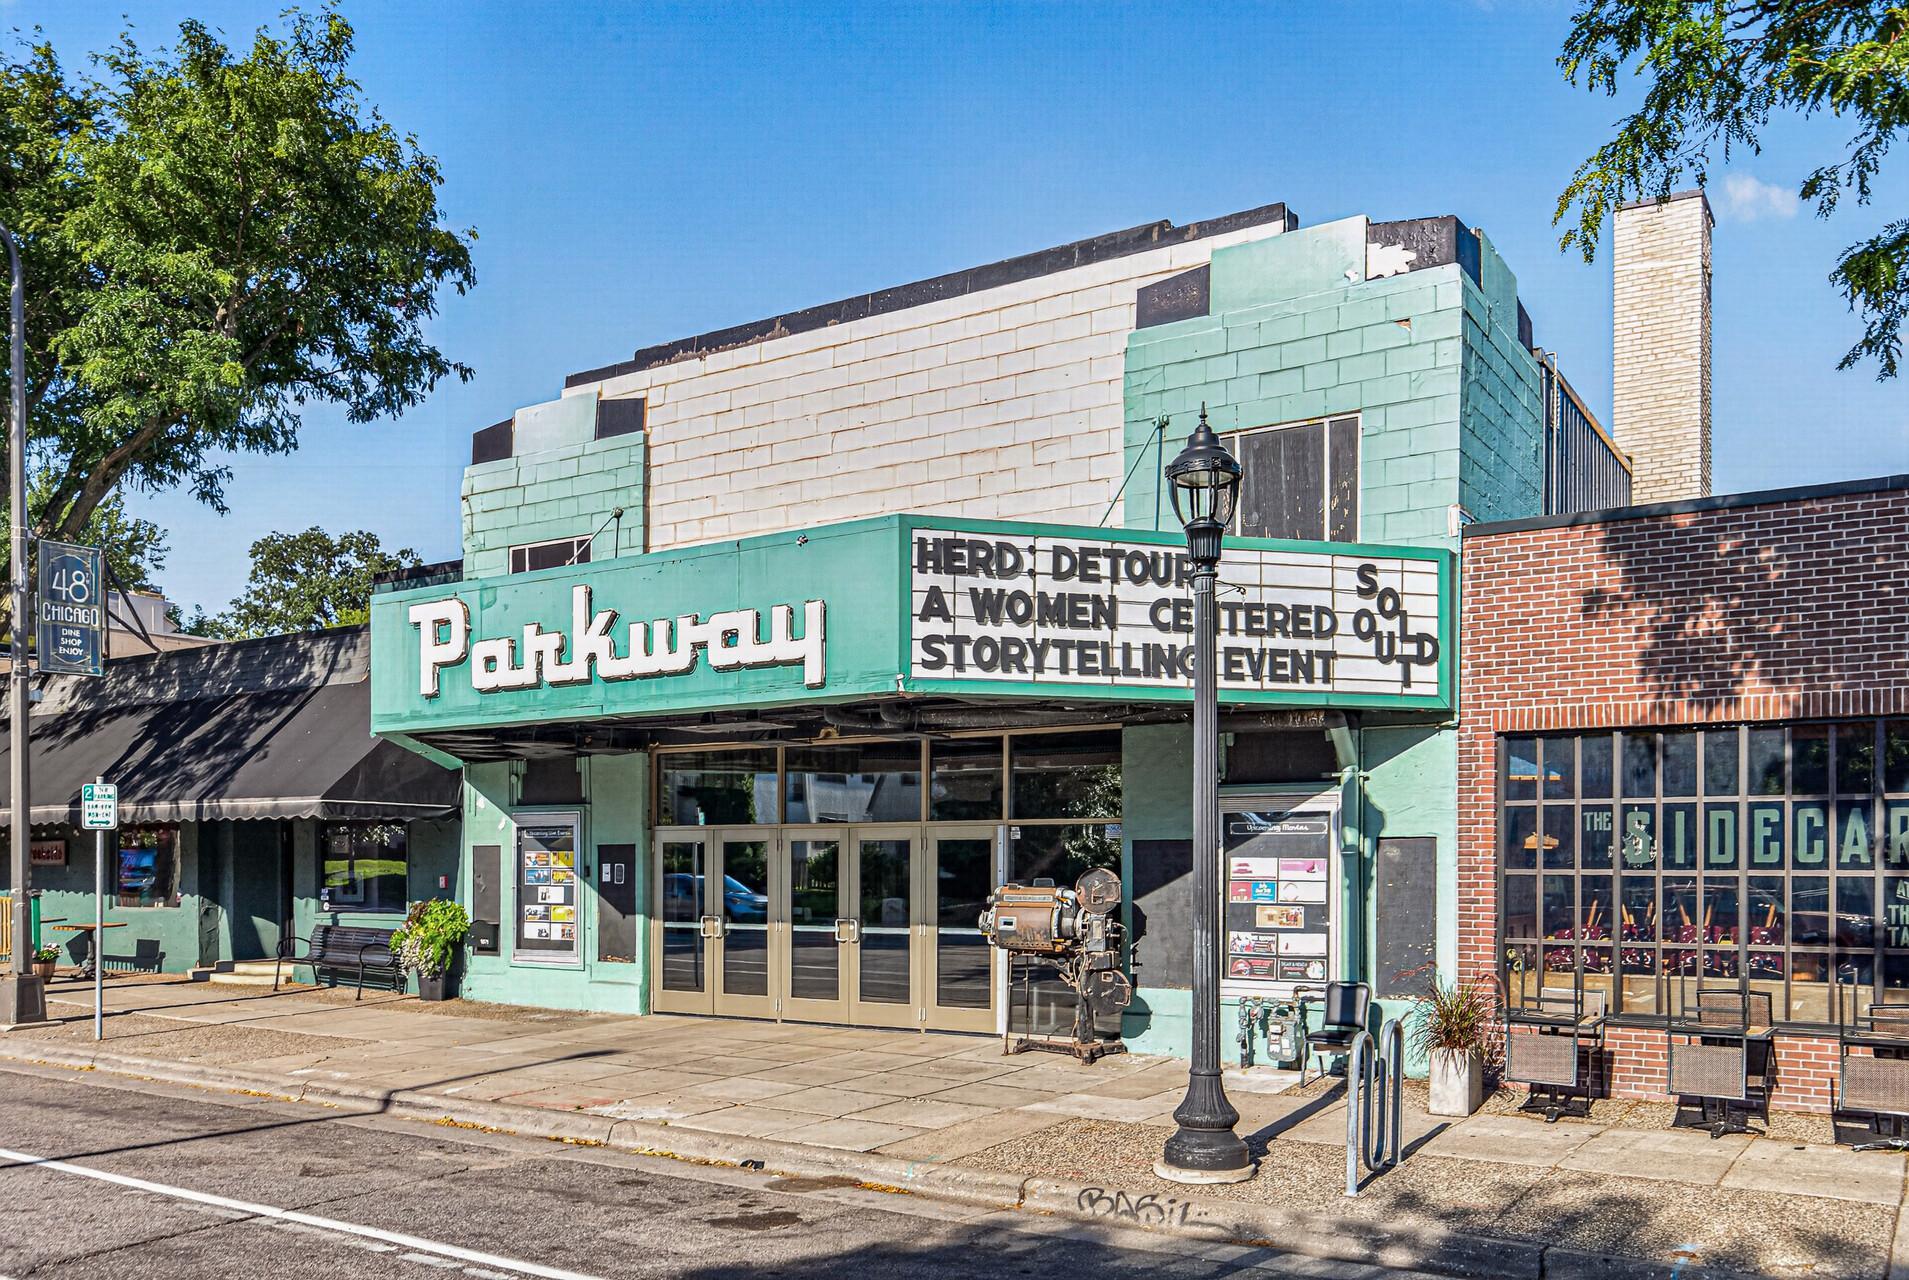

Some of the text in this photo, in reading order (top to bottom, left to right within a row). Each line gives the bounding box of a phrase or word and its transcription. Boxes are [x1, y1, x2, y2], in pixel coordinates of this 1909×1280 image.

[1052, 545, 1197, 588] DETOUR
[42, 602, 98, 627] CHICAGO
[918, 585, 1338, 640] A WOMEN CETERED
[60, 638, 82, 646] SHOP
[62, 628, 80, 637] DINE
[408, 584, 827, 699] Parkway
[59, 646, 84, 656] ENJOY
[921, 634, 1337, 684] STORYTELLING EVENT
[84, 787, 93, 799] 2
[1582, 807, 1909, 864] THE SIDECAR
[1887, 904, 1909, 925] TH
[1887, 926, 1909, 947] TA
